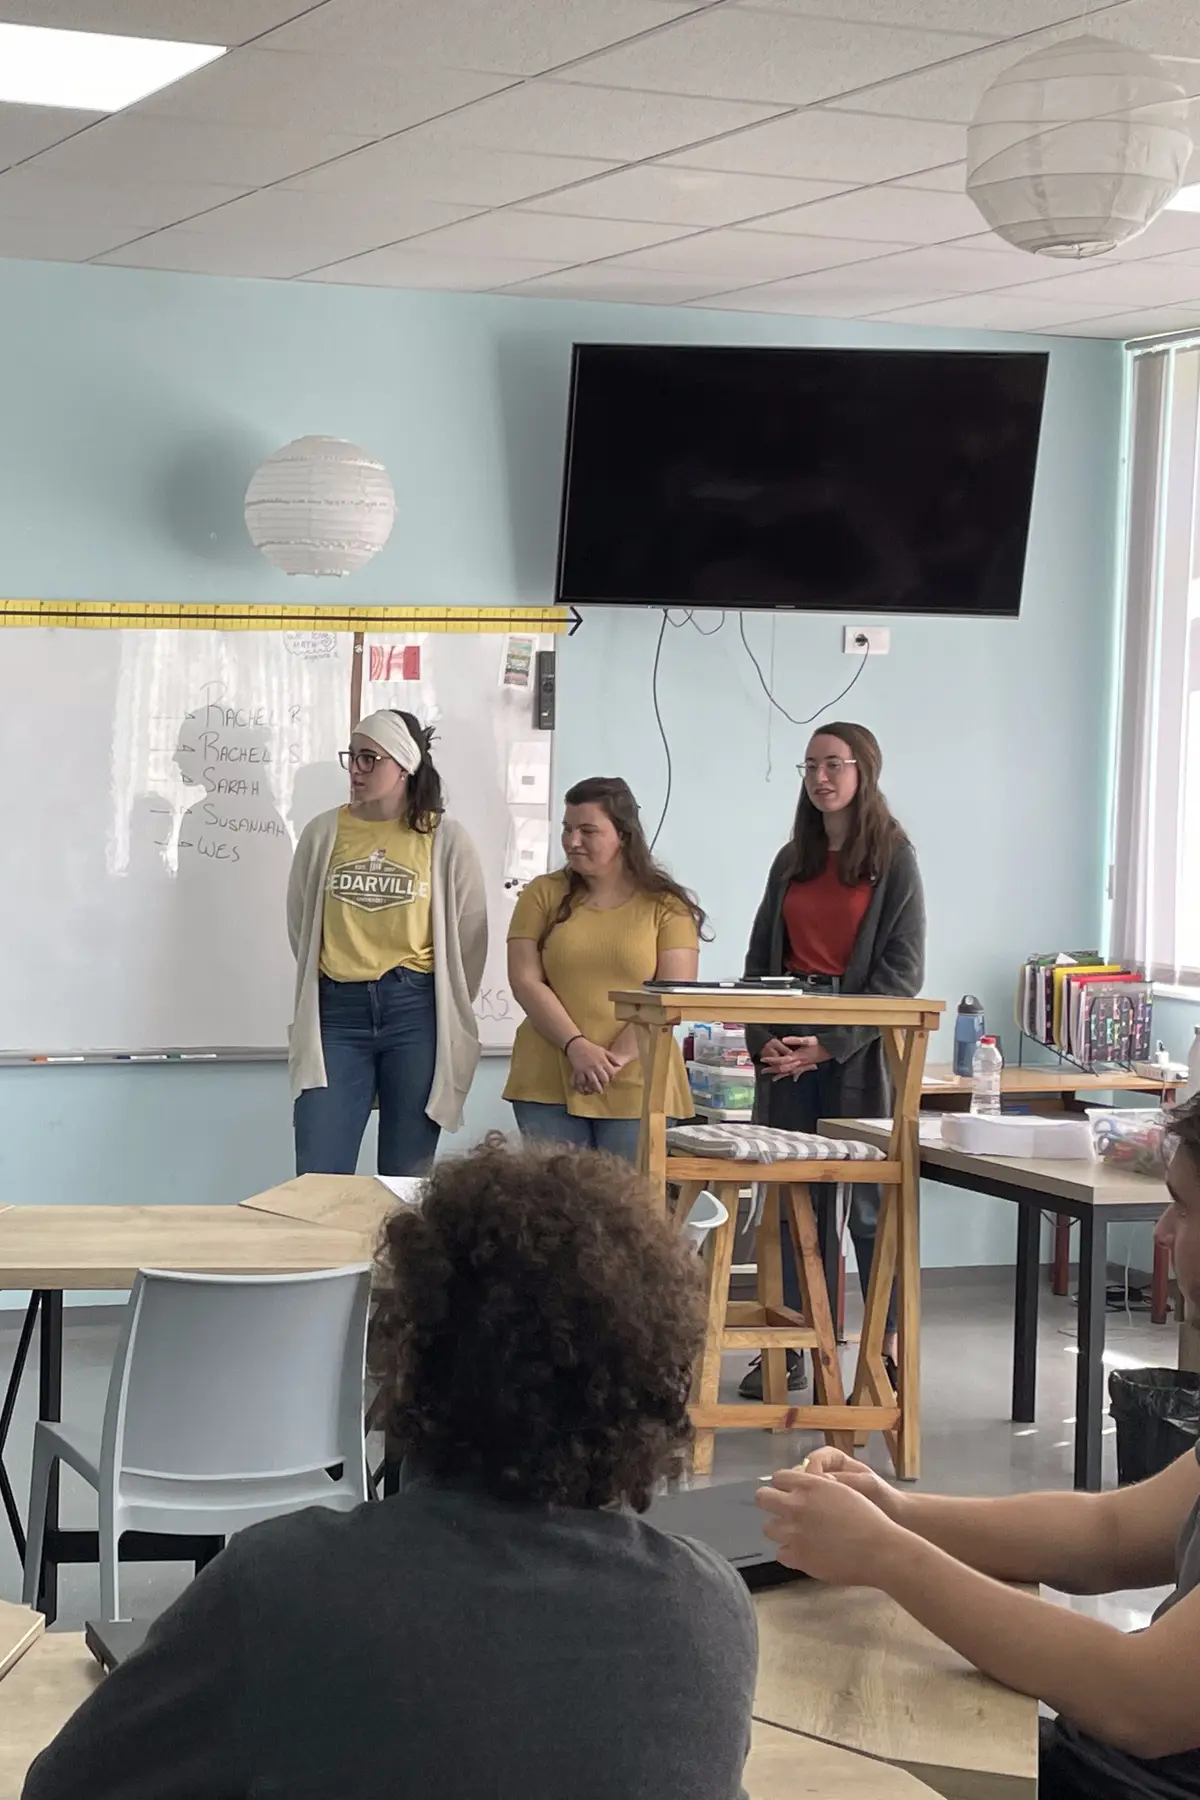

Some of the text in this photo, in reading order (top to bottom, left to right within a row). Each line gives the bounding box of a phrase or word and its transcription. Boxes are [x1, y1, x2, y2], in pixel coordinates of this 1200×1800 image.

[200, 680, 301, 728] RACHEL R
[198, 731, 301, 763] RACHEL S
[203, 766, 259, 795] SARAH
[203, 803, 285, 838] SUSANNAH
[197, 836, 240, 862] WES
